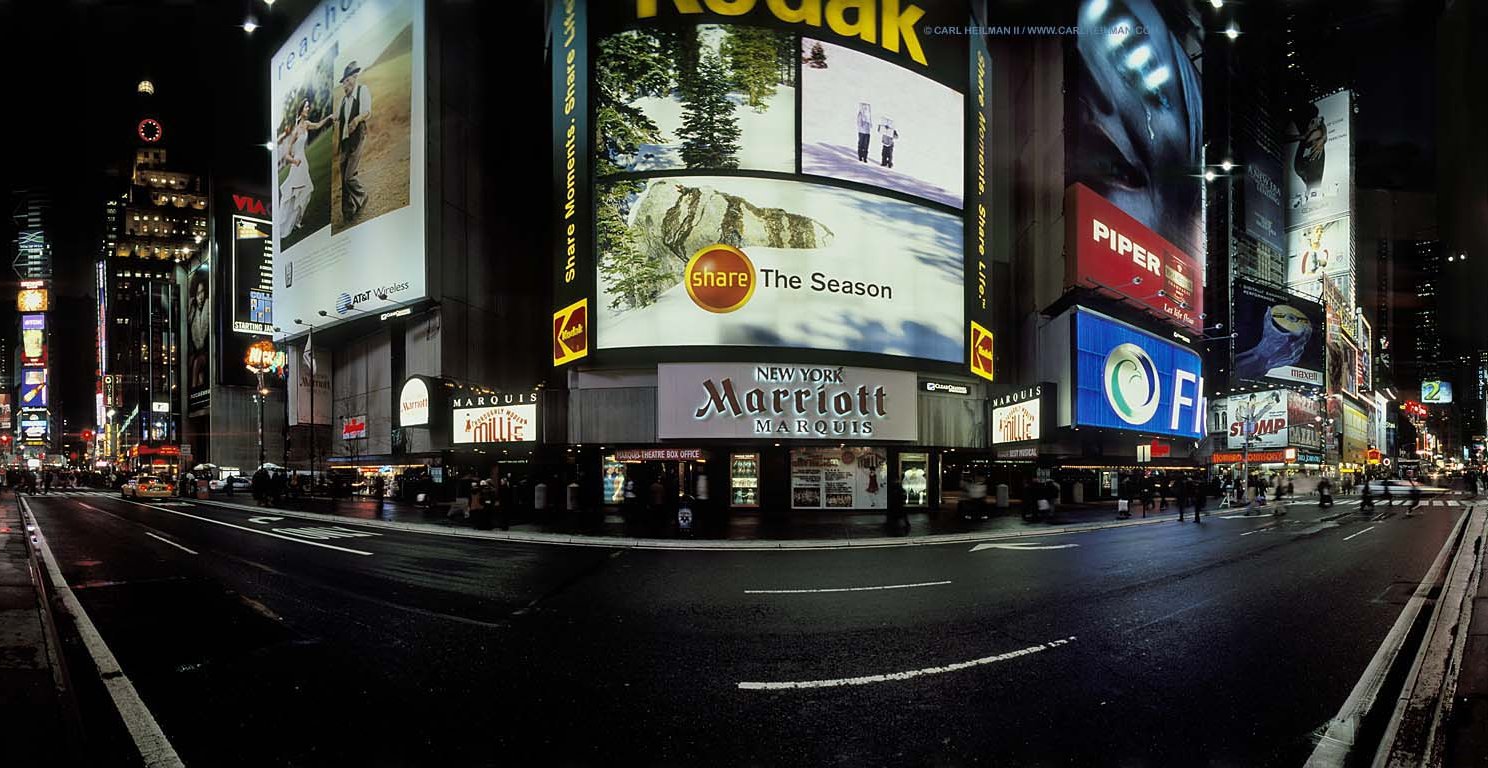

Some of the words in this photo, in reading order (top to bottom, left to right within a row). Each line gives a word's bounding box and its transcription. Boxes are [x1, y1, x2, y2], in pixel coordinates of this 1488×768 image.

[635, 0, 929, 67] dak
[564, 48, 577, 116] Share
[976, 51, 987, 107] Share
[977, 110, 986, 197] Moments.
[565, 117, 576, 220] Moments.
[978, 203, 987, 257] Share
[565, 223, 577, 284] Share
[1093, 218, 1162, 277] PIPER
[352, 290, 372, 306] AT&T
[373, 281, 410, 299] Wireless
[691, 266, 749, 288] share
[760, 268, 803, 290] The
[810, 272, 893, 300] Season
[234, 321, 263, 331] STARTING
[561, 323, 584, 341] Kodak
[757, 366, 796, 383] NEW
[799, 366, 845, 383] YORK
[1290, 368, 1318, 382] maxell
[453, 393, 538, 408] MARQUIS
[695, 377, 888, 418] Marriott
[992, 385, 1042, 408] MARQUIS
[1422, 381, 1441, 402] 2
[403, 398, 428, 412] Marriott
[755, 419, 873, 435] MARQUIS
[641, 450, 665, 459] THEATRE
[666, 450, 679, 459] BOX
[679, 449, 700, 459] OFFICE
